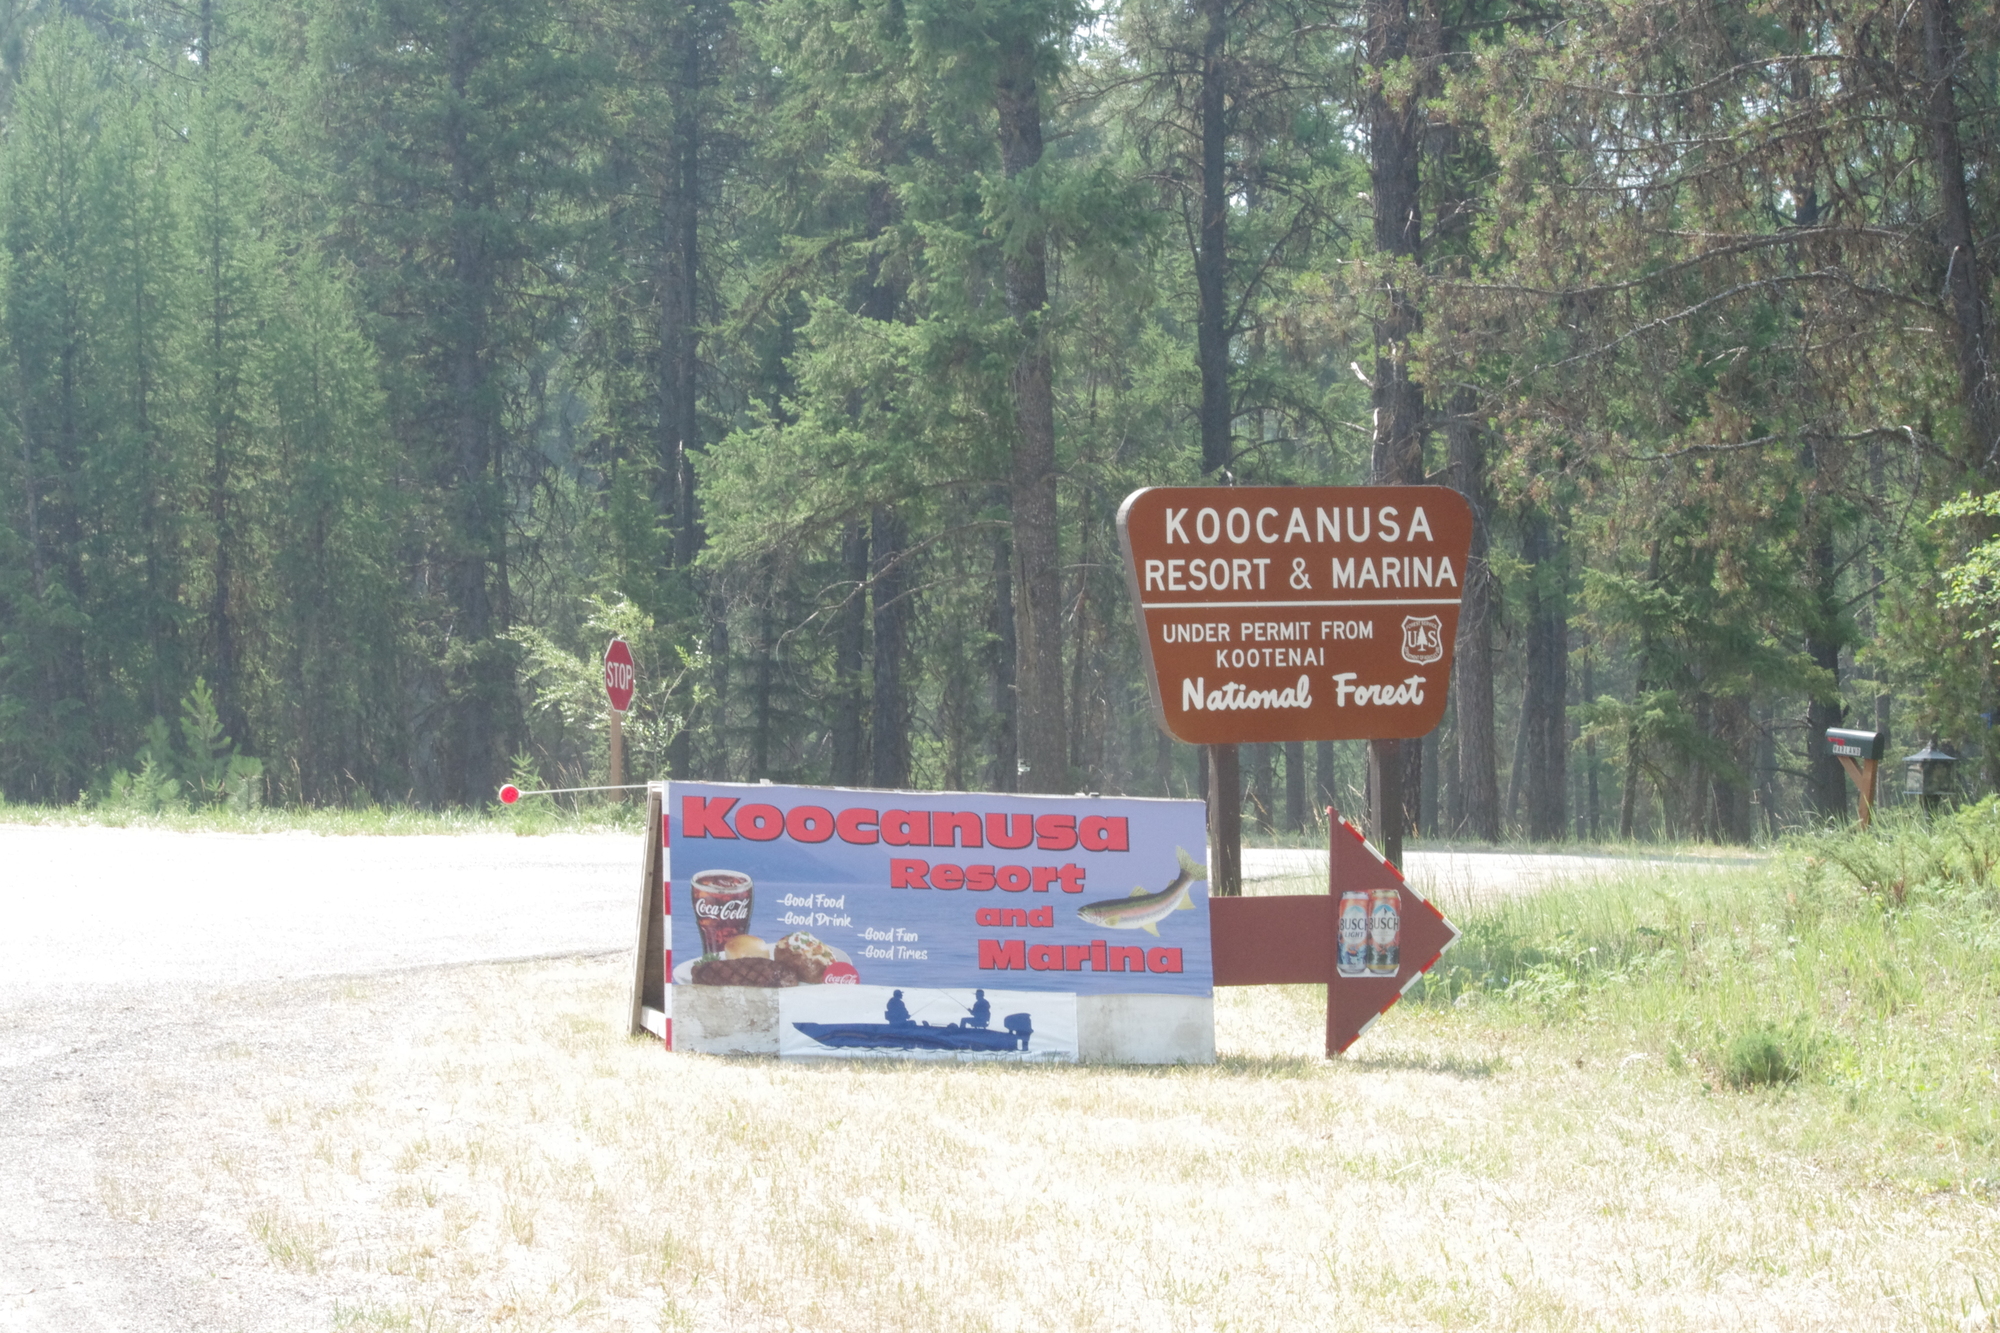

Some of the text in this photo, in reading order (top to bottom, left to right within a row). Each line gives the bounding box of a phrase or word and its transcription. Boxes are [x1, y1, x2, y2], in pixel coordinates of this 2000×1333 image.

[1165, 506, 1434, 545] KOOCANUSA
[1145, 556, 1457, 591] RESORT & MARINA
[1163, 620, 1373, 643] UNDER PERMIT FROM
[1216, 647, 1325, 668] KOOTENAI
[607, 661, 633, 690] STOP
[1182, 672, 1427, 712] National Forest
[682, 795, 1130, 852] Koocanusa
[890, 858, 1086, 893] Resort
[696, 898, 749, 920] Coca-Cola
[815, 894, 845, 909] Food
[815, 912, 853, 928] Drink
[975, 905, 1054, 928] and
[896, 927, 918, 942] Fun
[977, 939, 1184, 974] Marina
